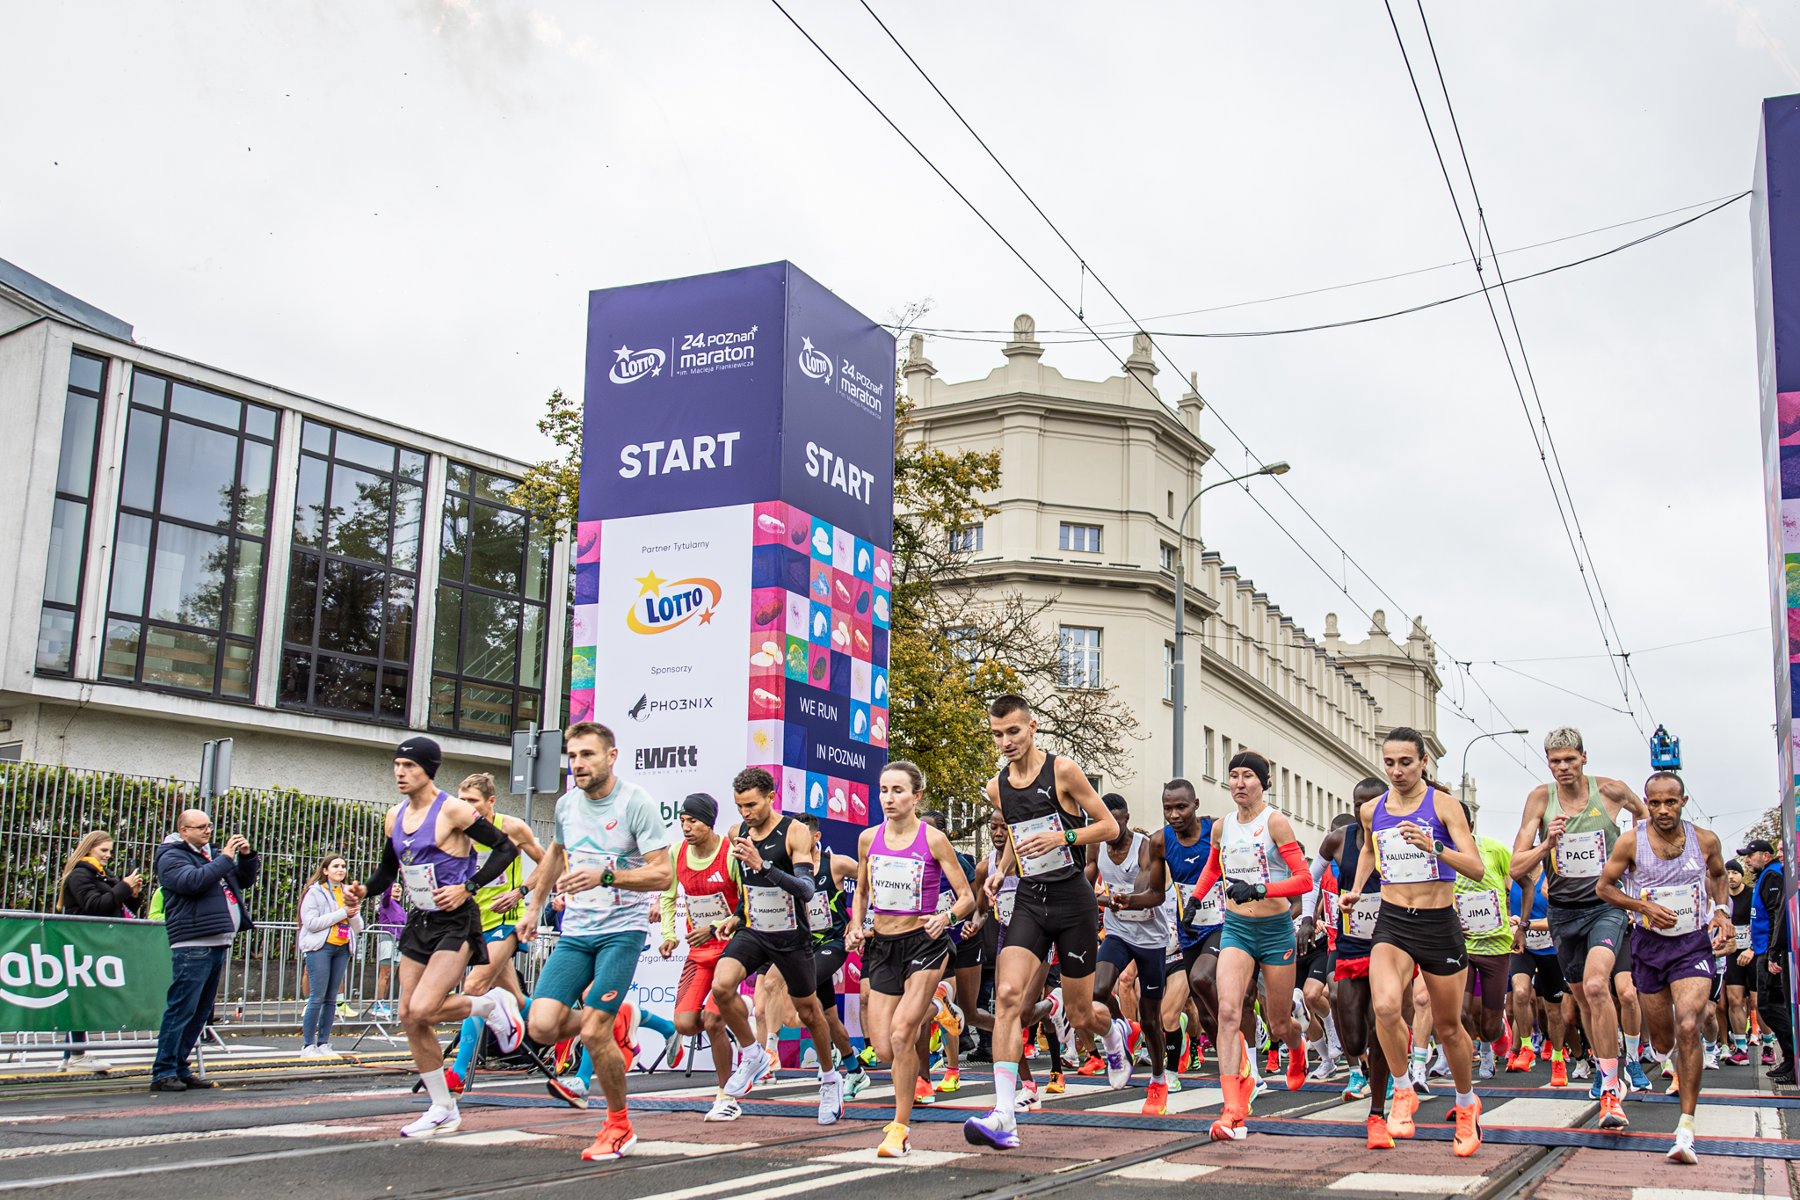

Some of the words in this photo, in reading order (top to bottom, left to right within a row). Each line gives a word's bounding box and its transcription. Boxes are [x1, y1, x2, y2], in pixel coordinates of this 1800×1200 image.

[681, 333, 706, 351] 24.
[620, 354, 655, 377] LOTTO
[680, 345, 755, 368] maraton
[805, 351, 827, 373] LOTTO
[690, 366, 714, 375] Macieja
[841, 359, 856, 380] 24.
[841, 377, 881, 413] maraton
[618, 431, 741, 479] START
[804, 441, 875, 505] START
[641, 543, 671, 554] Partner
[673, 540, 710, 552] Tytularny
[646, 587, 703, 623] LOTTO
[651, 665, 693, 676] Sponsorzy
[799, 696, 816, 716] WE
[817, 702, 838, 722] RUN
[644, 746, 698, 769] Witt
[816, 743, 826, 760] IN
[828, 746, 866, 770] POZNAN
[1385, 852, 1426, 861] KALIUZHNA
[1566, 849, 1595, 861] PACE
[875, 880, 911, 890] NYZHNYK
[1002, 910, 1013, 918] CH
[1357, 910, 1380, 921] PAC
[1467, 907, 1491, 918] JIMA
[1673, 907, 1693, 916] NGUL
[0, 943, 126, 987] abka
[638, 954, 688, 965] Organzator
